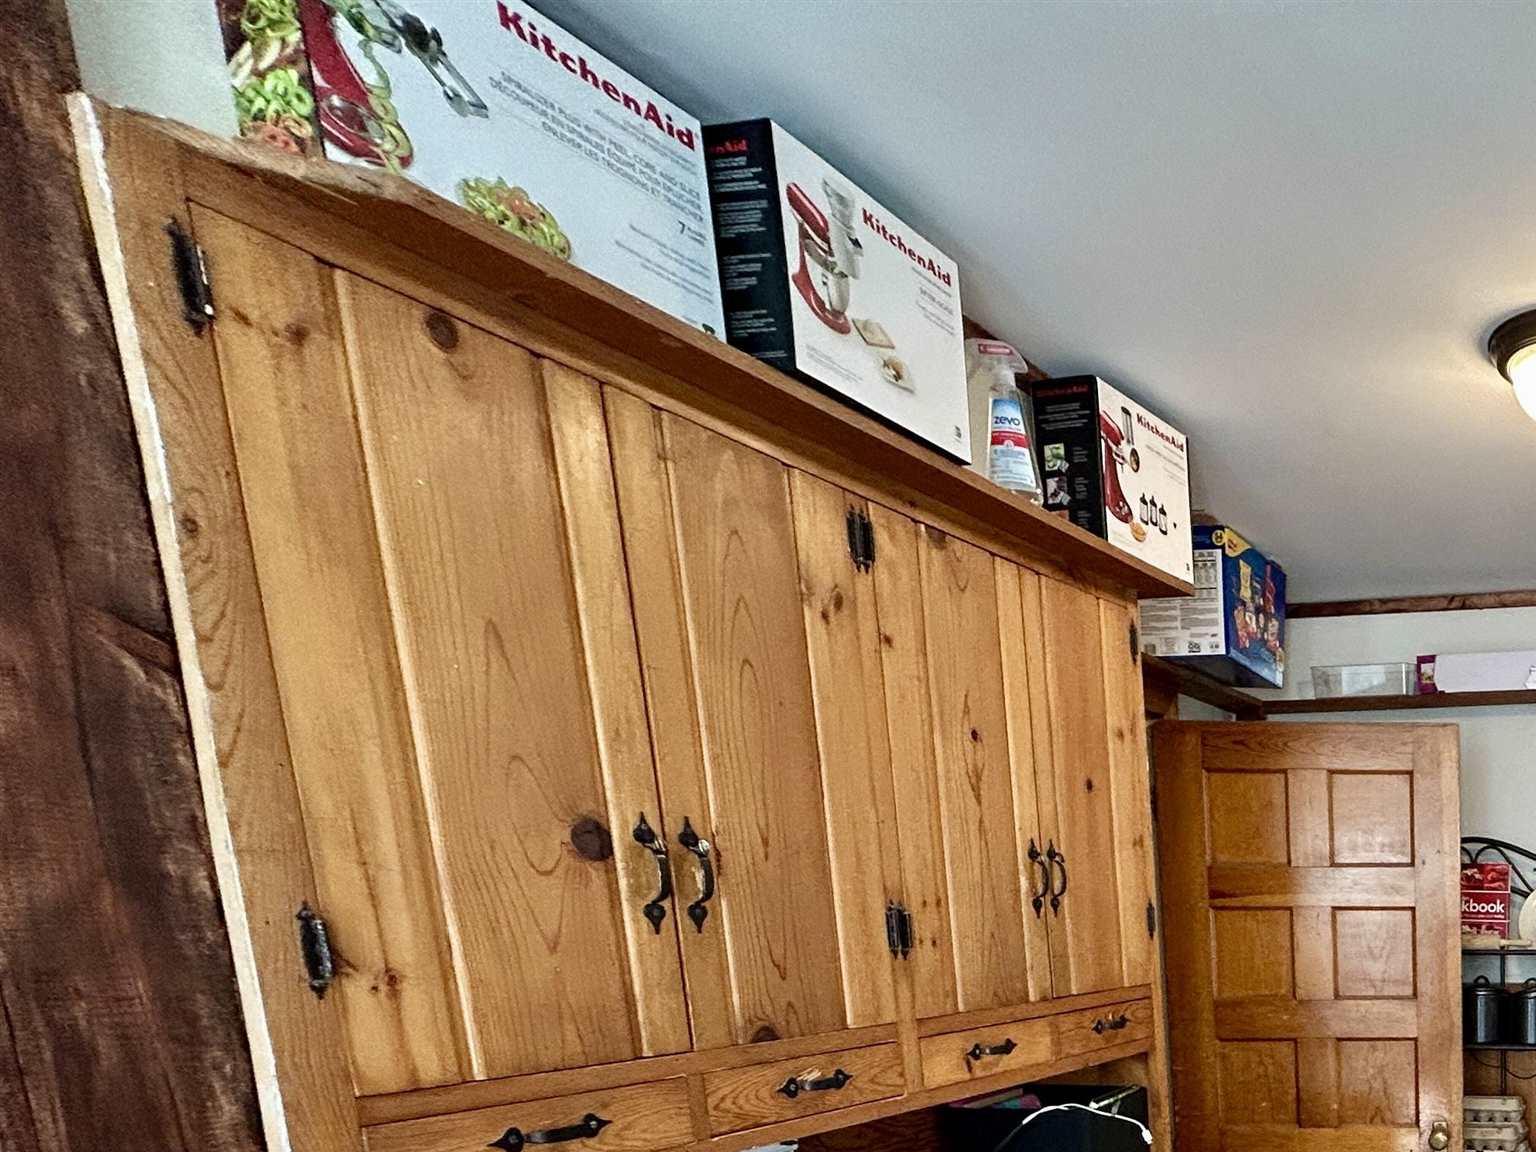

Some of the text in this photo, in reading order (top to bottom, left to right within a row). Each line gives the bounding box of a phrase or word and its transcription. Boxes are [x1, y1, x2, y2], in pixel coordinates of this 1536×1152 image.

[496, 0, 696, 152] KitchenAid
[861, 206, 952, 288] KitchenAid
[993, 415, 1021, 427] zevo
[1136, 412, 1184, 453] KitchenAid
[1461, 899, 1505, 913] kbook
